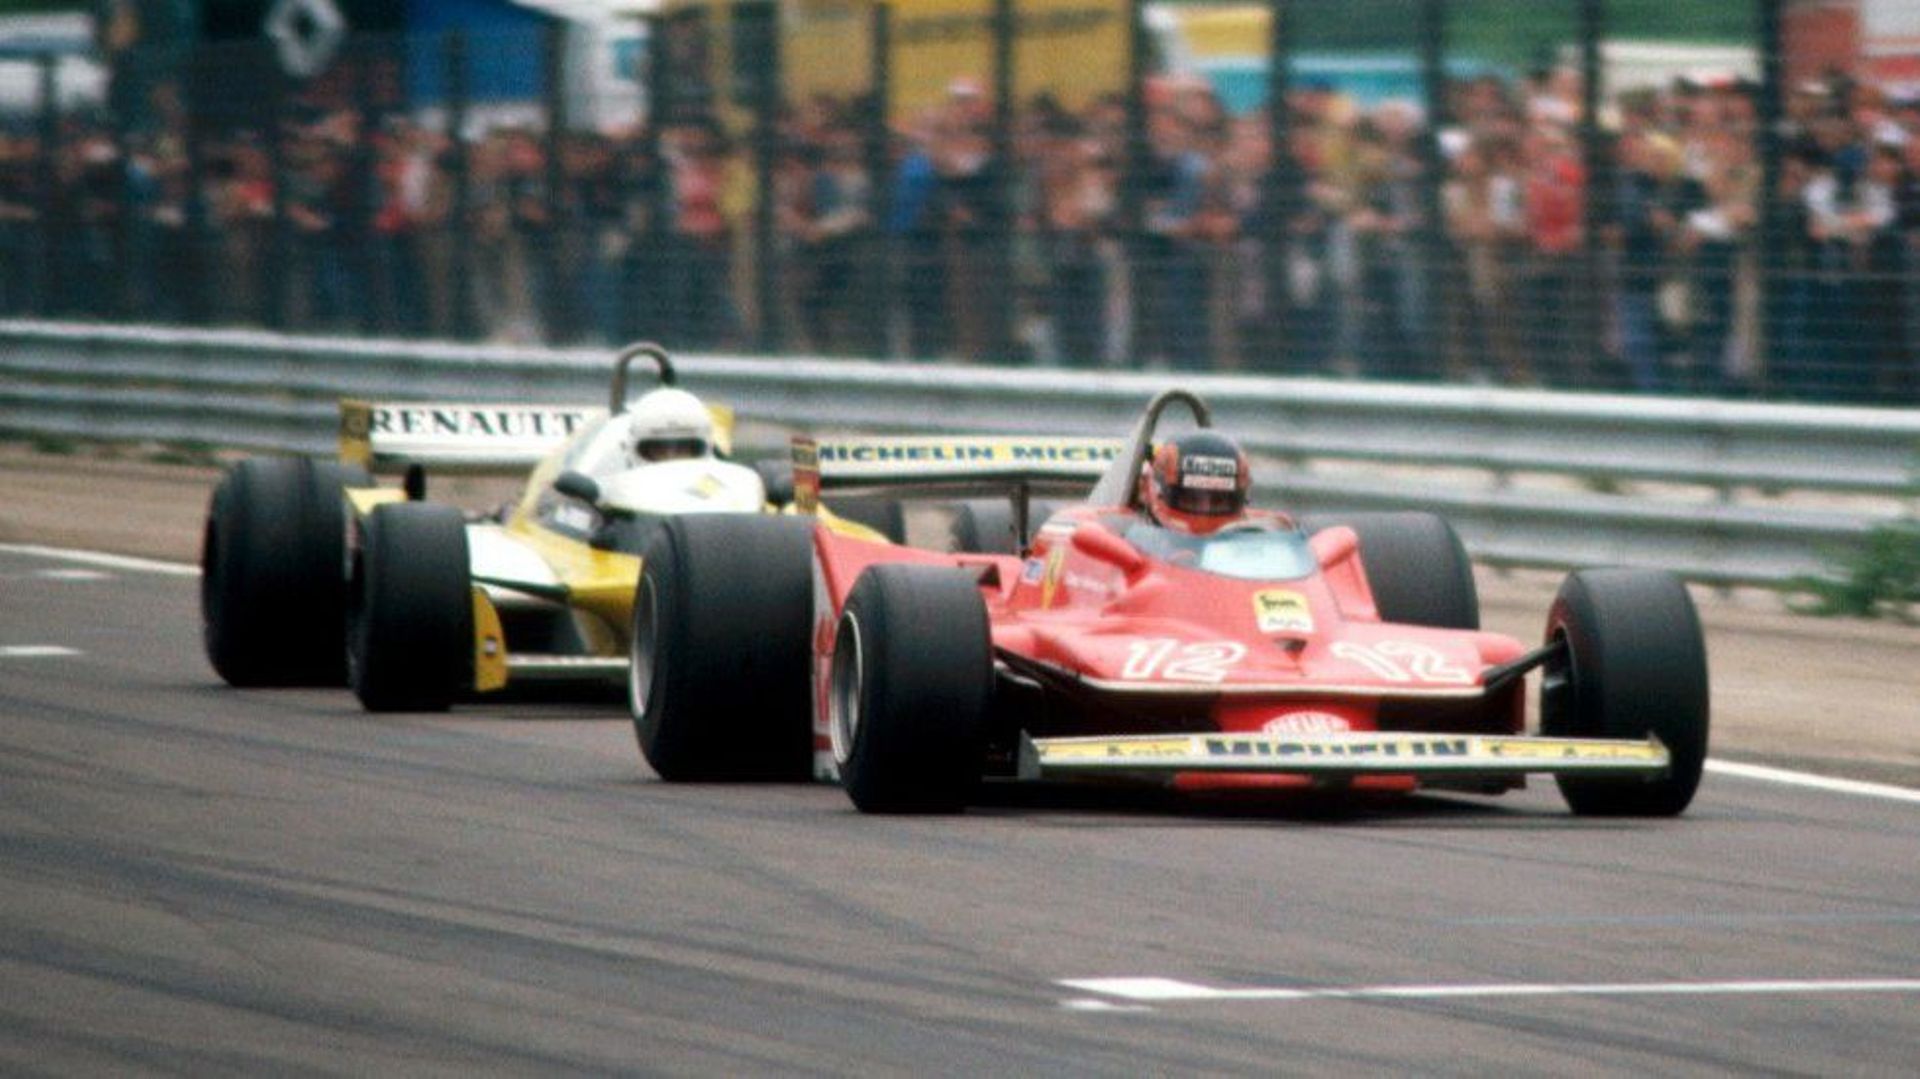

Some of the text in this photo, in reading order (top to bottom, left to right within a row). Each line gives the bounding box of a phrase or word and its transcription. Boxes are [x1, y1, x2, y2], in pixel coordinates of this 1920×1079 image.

[368, 408, 577, 435] RENAULT
[1012, 446, 1121, 461] MICH
[1121, 638, 1249, 683] 12
[1331, 640, 1476, 684] 12
